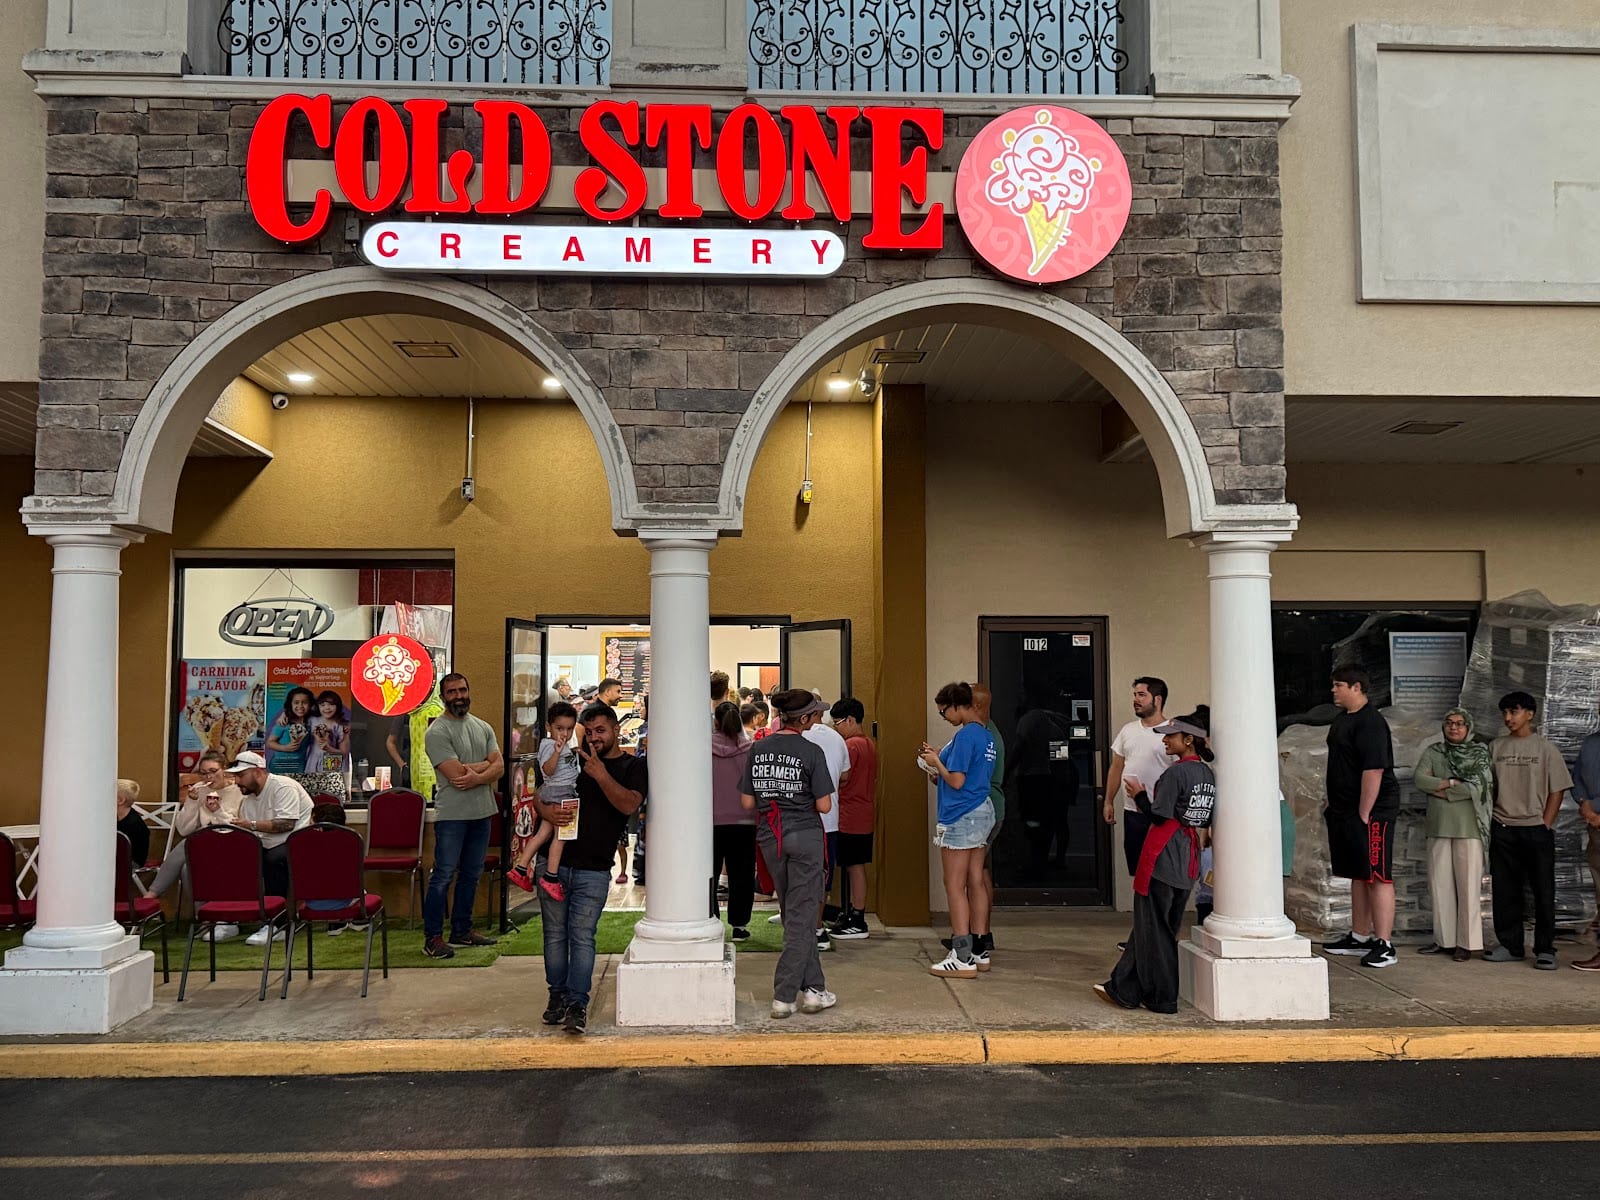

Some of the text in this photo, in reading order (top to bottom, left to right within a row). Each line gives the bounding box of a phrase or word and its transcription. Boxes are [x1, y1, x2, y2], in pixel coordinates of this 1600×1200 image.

[246, 93, 944, 251] COLD STONE
[376, 231, 830, 265] CREAMERY
[226, 607, 323, 642] OPEN
[1025, 639, 1047, 650] 1012
[297, 660, 313, 669] Join
[191, 666, 256, 677] CARNIVAL
[312, 666, 348, 675] Creamery
[198, 679, 247, 691] FLAVOR
[754, 753, 775, 764] COLD
[752, 764, 802, 779] CREAMERY
[752, 780, 768, 789] MADE
[785, 782, 803, 791] DAILY
[1371, 821, 1381, 866] adidas
